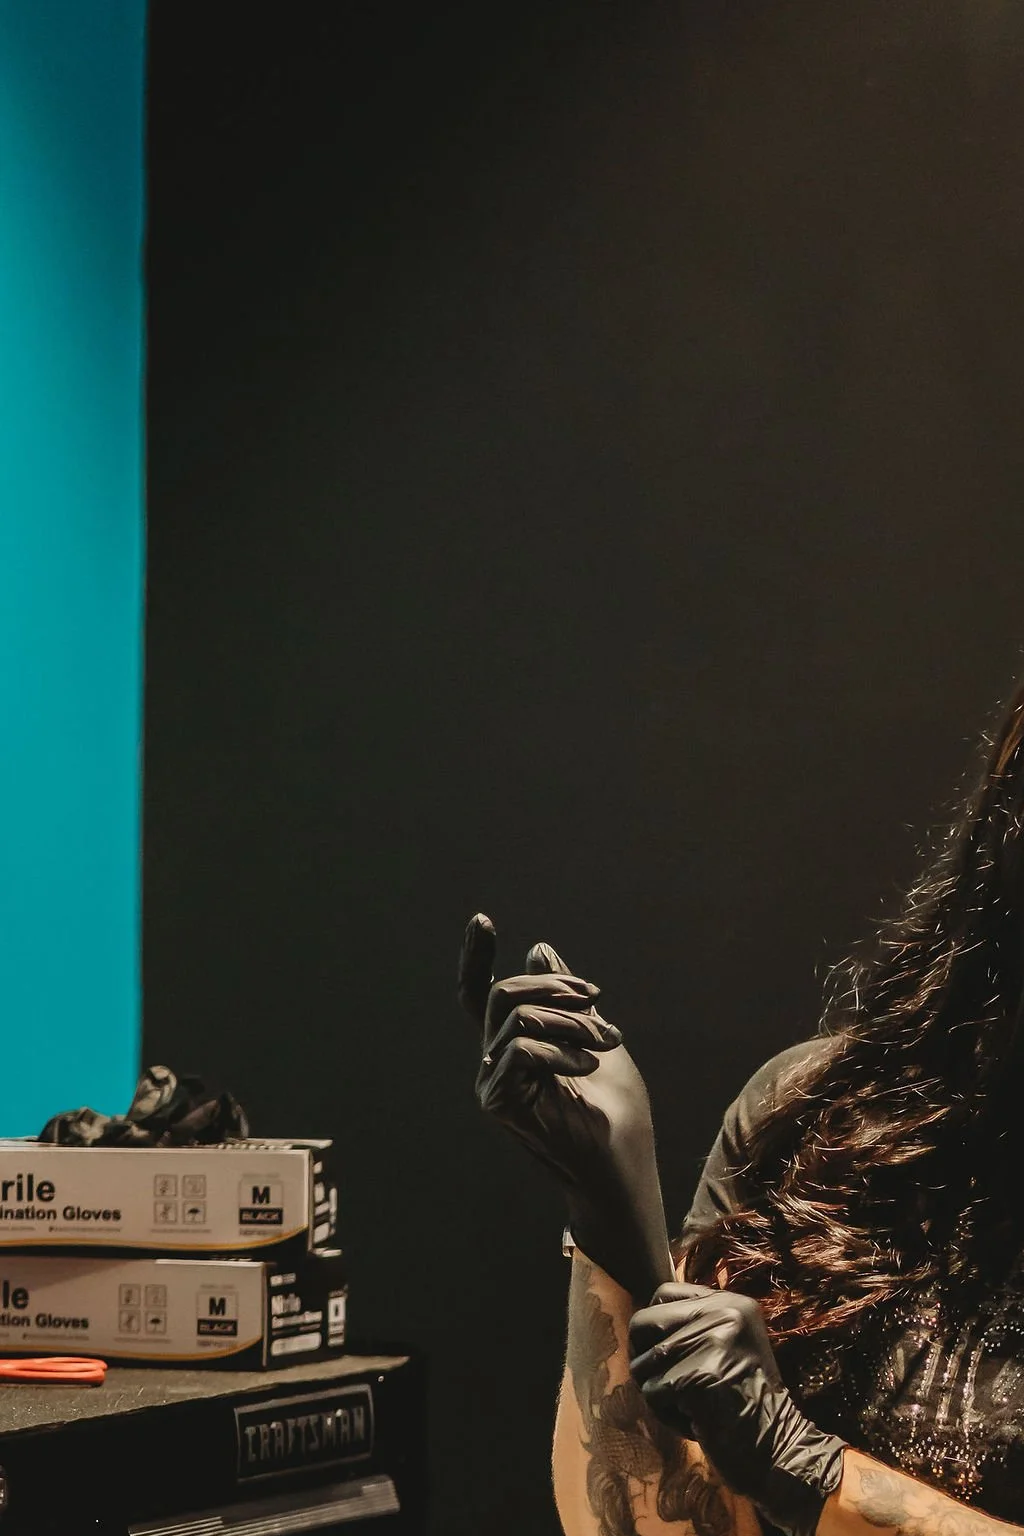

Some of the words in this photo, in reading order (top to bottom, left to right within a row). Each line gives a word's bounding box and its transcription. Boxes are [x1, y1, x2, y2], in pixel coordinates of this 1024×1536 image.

[2, 1173, 55, 1202] rile
[252, 1186, 270, 1204] M
[63, 1205, 121, 1220] Gloves
[209, 1296, 226, 1316] M
[36, 1313, 89, 1329] Gloves
[244, 1406, 365, 1462] CRAFTSMAN
